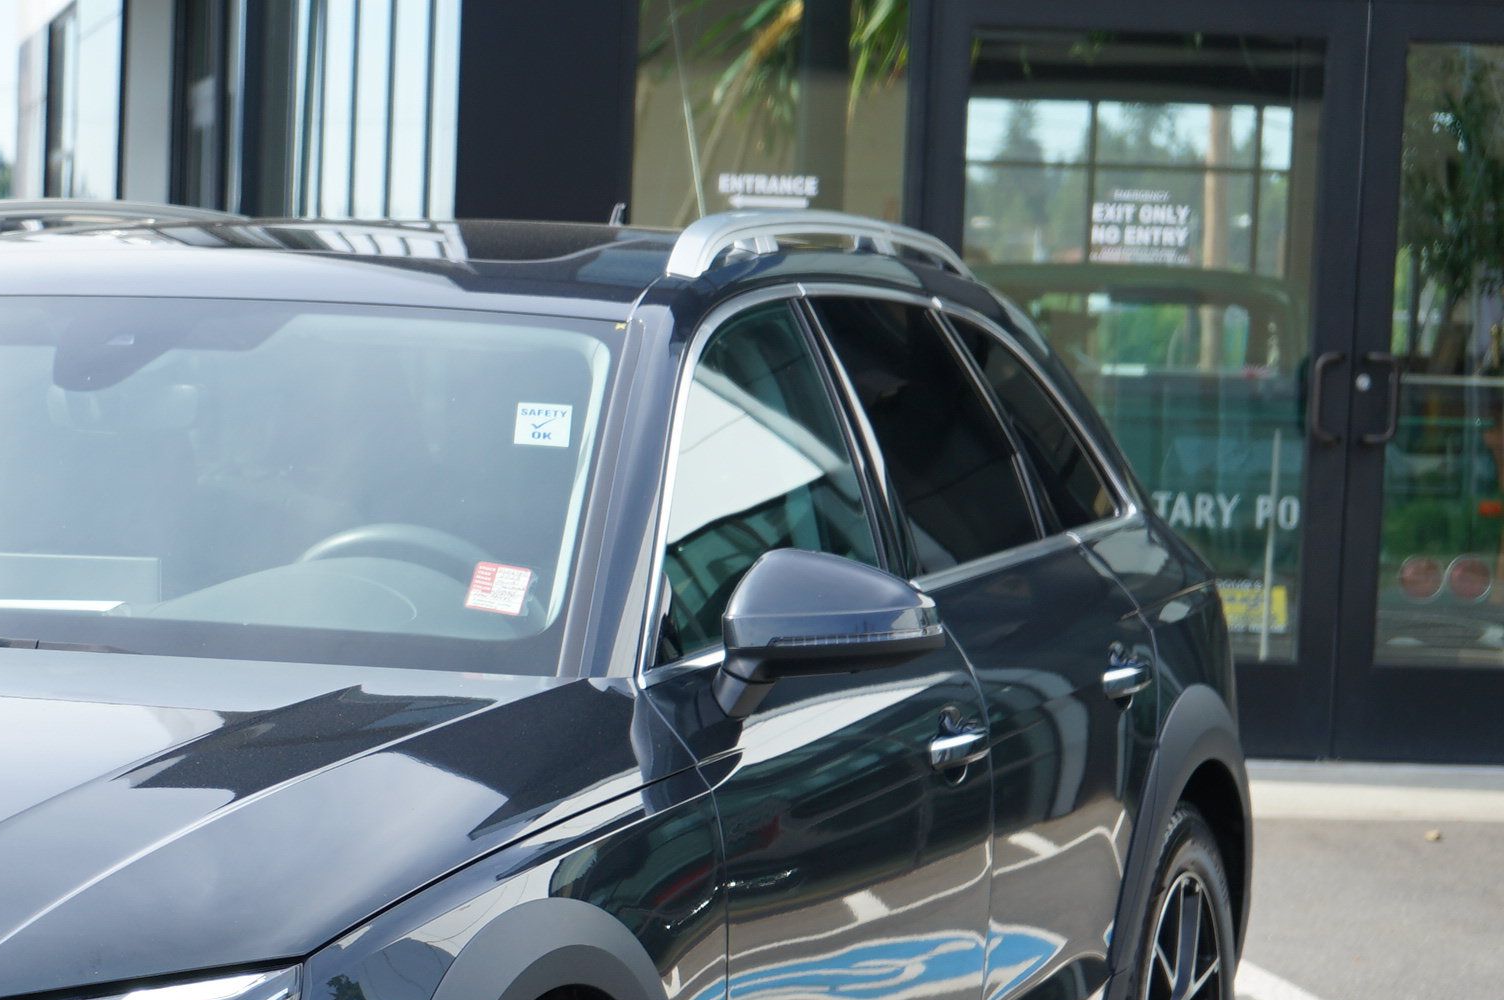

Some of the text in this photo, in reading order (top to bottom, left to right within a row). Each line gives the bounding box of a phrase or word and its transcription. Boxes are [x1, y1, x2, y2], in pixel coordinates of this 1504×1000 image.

[718, 173, 819, 196] ENTRANCE
[1092, 202, 1191, 226] EXIT ONLY
[1090, 223, 1189, 248] NO ENTRY
[520, 408, 568, 418] SAFETY
[531, 430, 553, 441] OK
